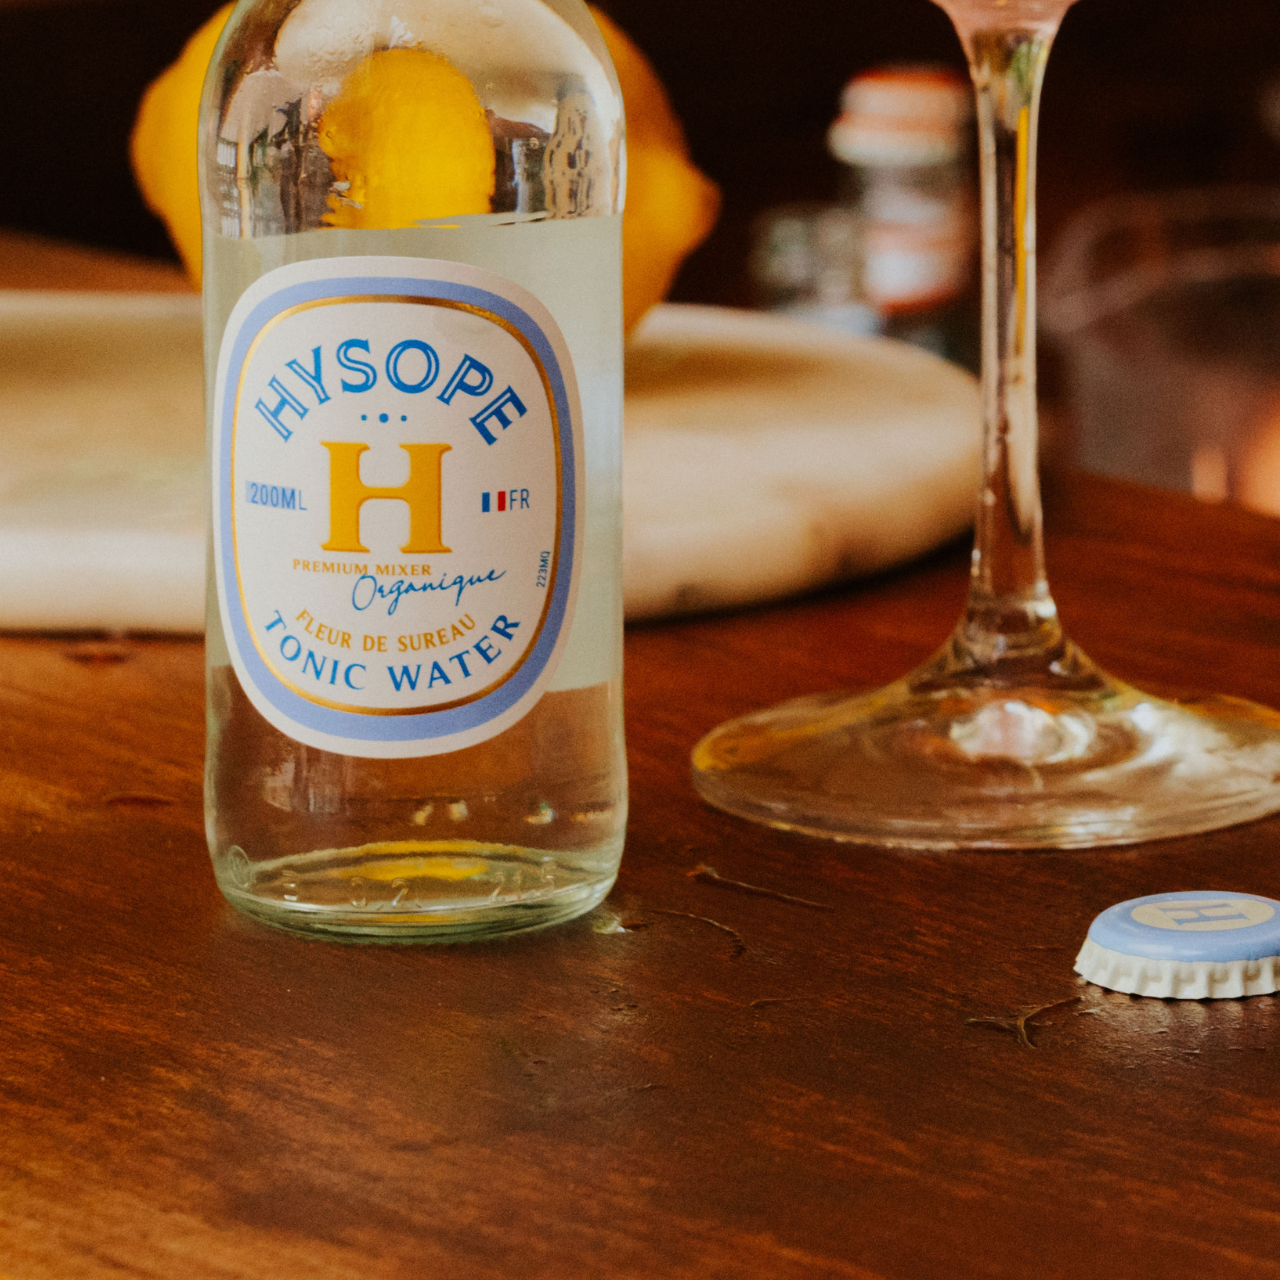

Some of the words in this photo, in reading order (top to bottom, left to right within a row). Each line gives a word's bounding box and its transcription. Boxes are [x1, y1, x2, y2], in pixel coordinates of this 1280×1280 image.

[254, 338, 528, 446] HYSOPE
[250, 482, 308, 511] 200ML
[319, 440, 453, 554] H
[509, 488, 531, 511] FR
[293, 558, 368, 575] PREMIUM
[375, 563, 432, 576] MIXER
[352, 570, 507, 616] Organique
[264, 610, 367, 691] TONIC
[386, 614, 521, 692] WATER
[295, 608, 352, 650] FLEUR
[362, 635, 388, 653] DE
[397, 614, 477, 653] SUREAU
